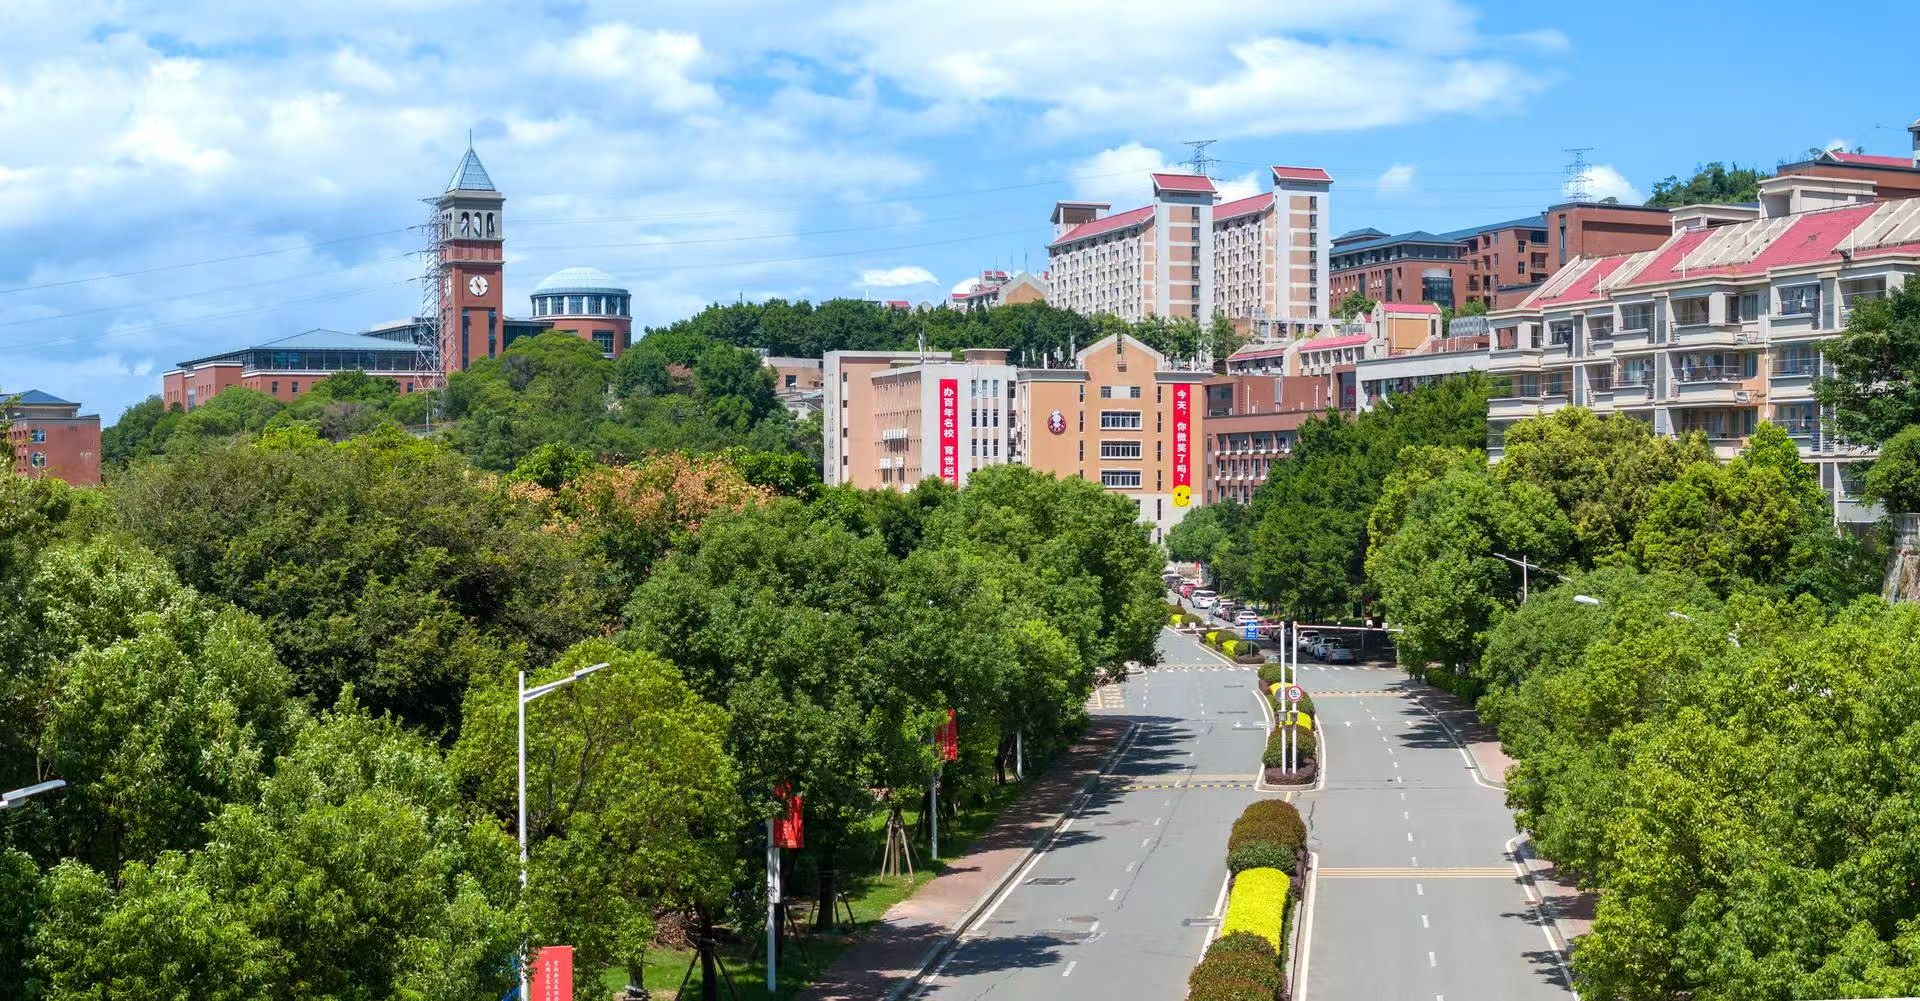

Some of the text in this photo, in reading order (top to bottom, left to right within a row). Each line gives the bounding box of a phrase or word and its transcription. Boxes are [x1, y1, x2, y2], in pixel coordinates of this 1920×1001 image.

[943, 387, 954, 438] 办百年名校
